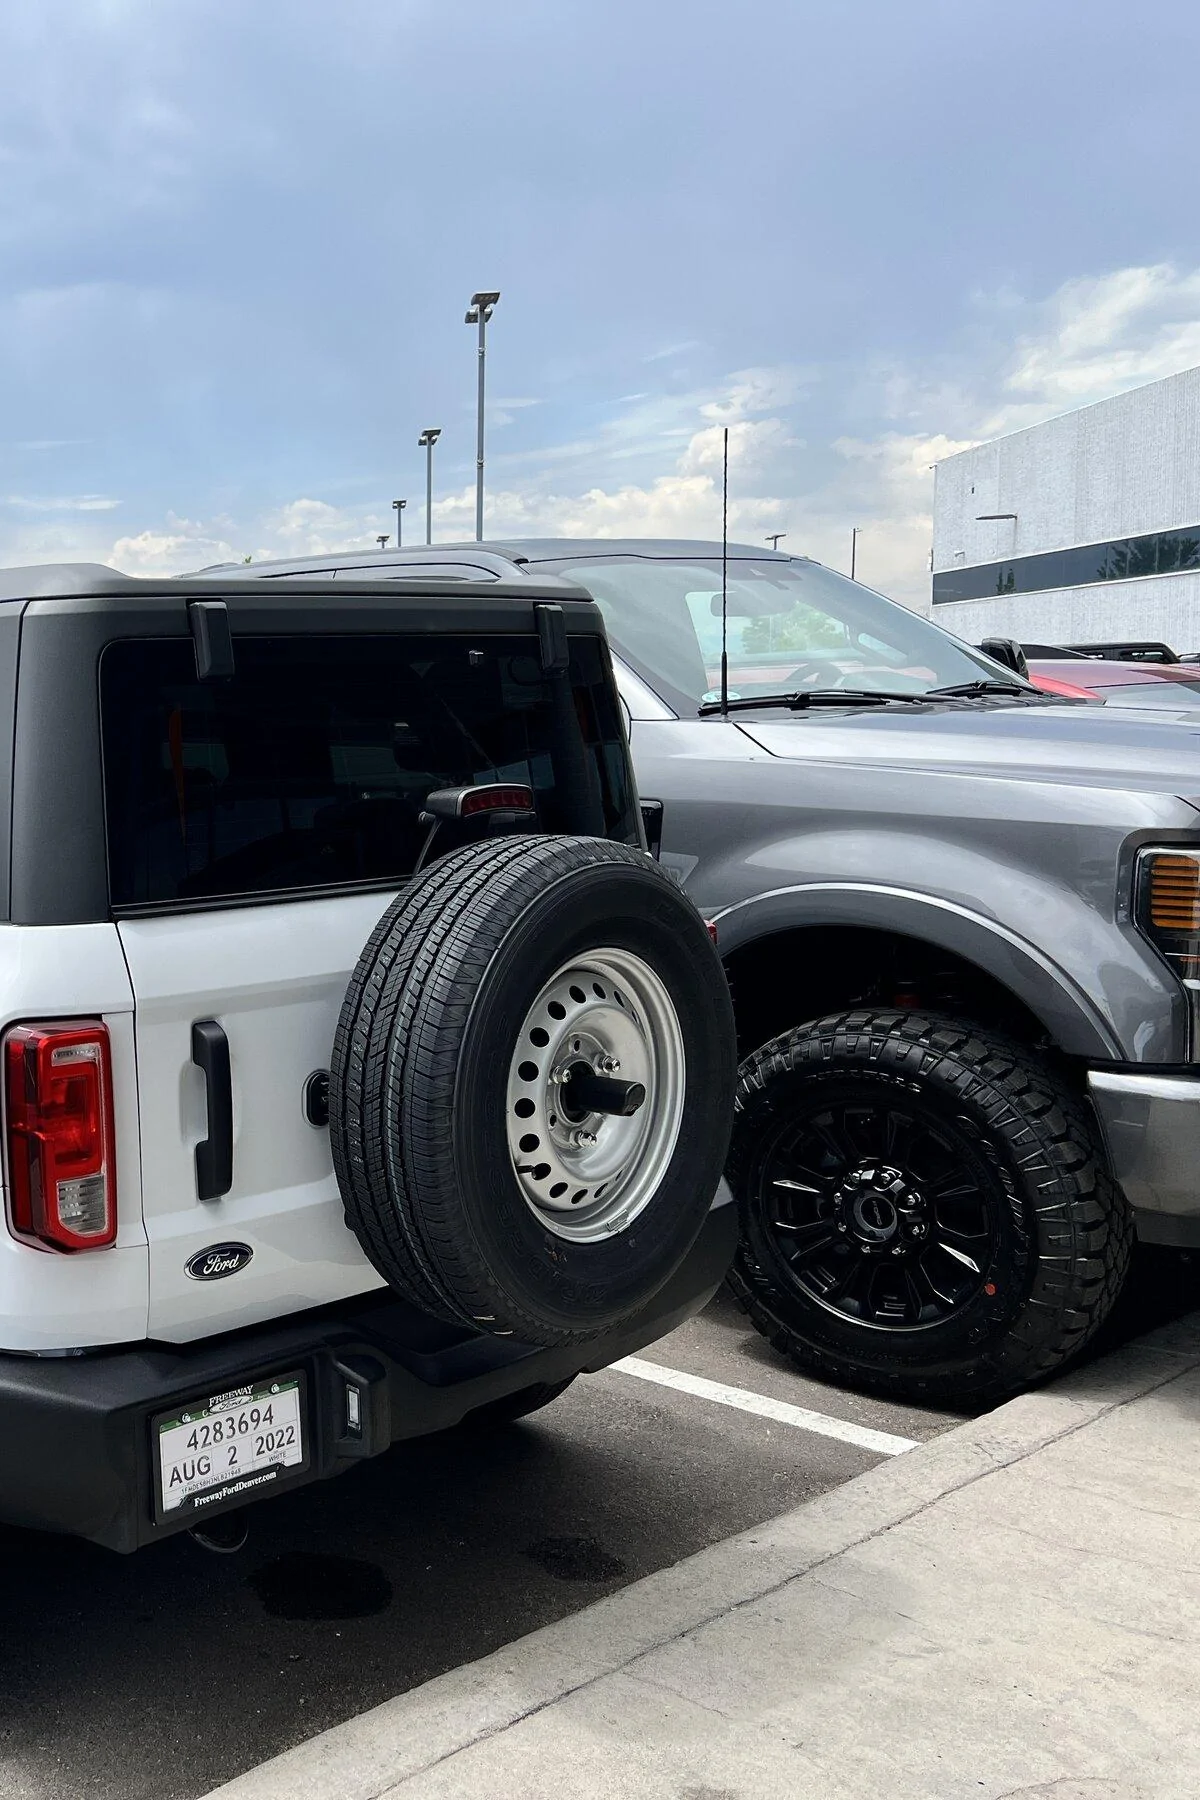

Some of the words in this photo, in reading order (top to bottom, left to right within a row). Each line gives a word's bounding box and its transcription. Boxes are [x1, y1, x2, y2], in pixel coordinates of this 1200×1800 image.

[203, 1250, 240, 1275] Ford
[208, 1385, 254, 1408] FREEWAY
[186, 1404, 274, 1451] 4283694
[169, 1454, 211, 1487] AUG
[227, 1445, 238, 1466] 2
[255, 1425, 296, 1456] 2022
[268, 1451, 287, 1463] WHITE
[193, 1470, 277, 1508] FreewayFordDenver.com
